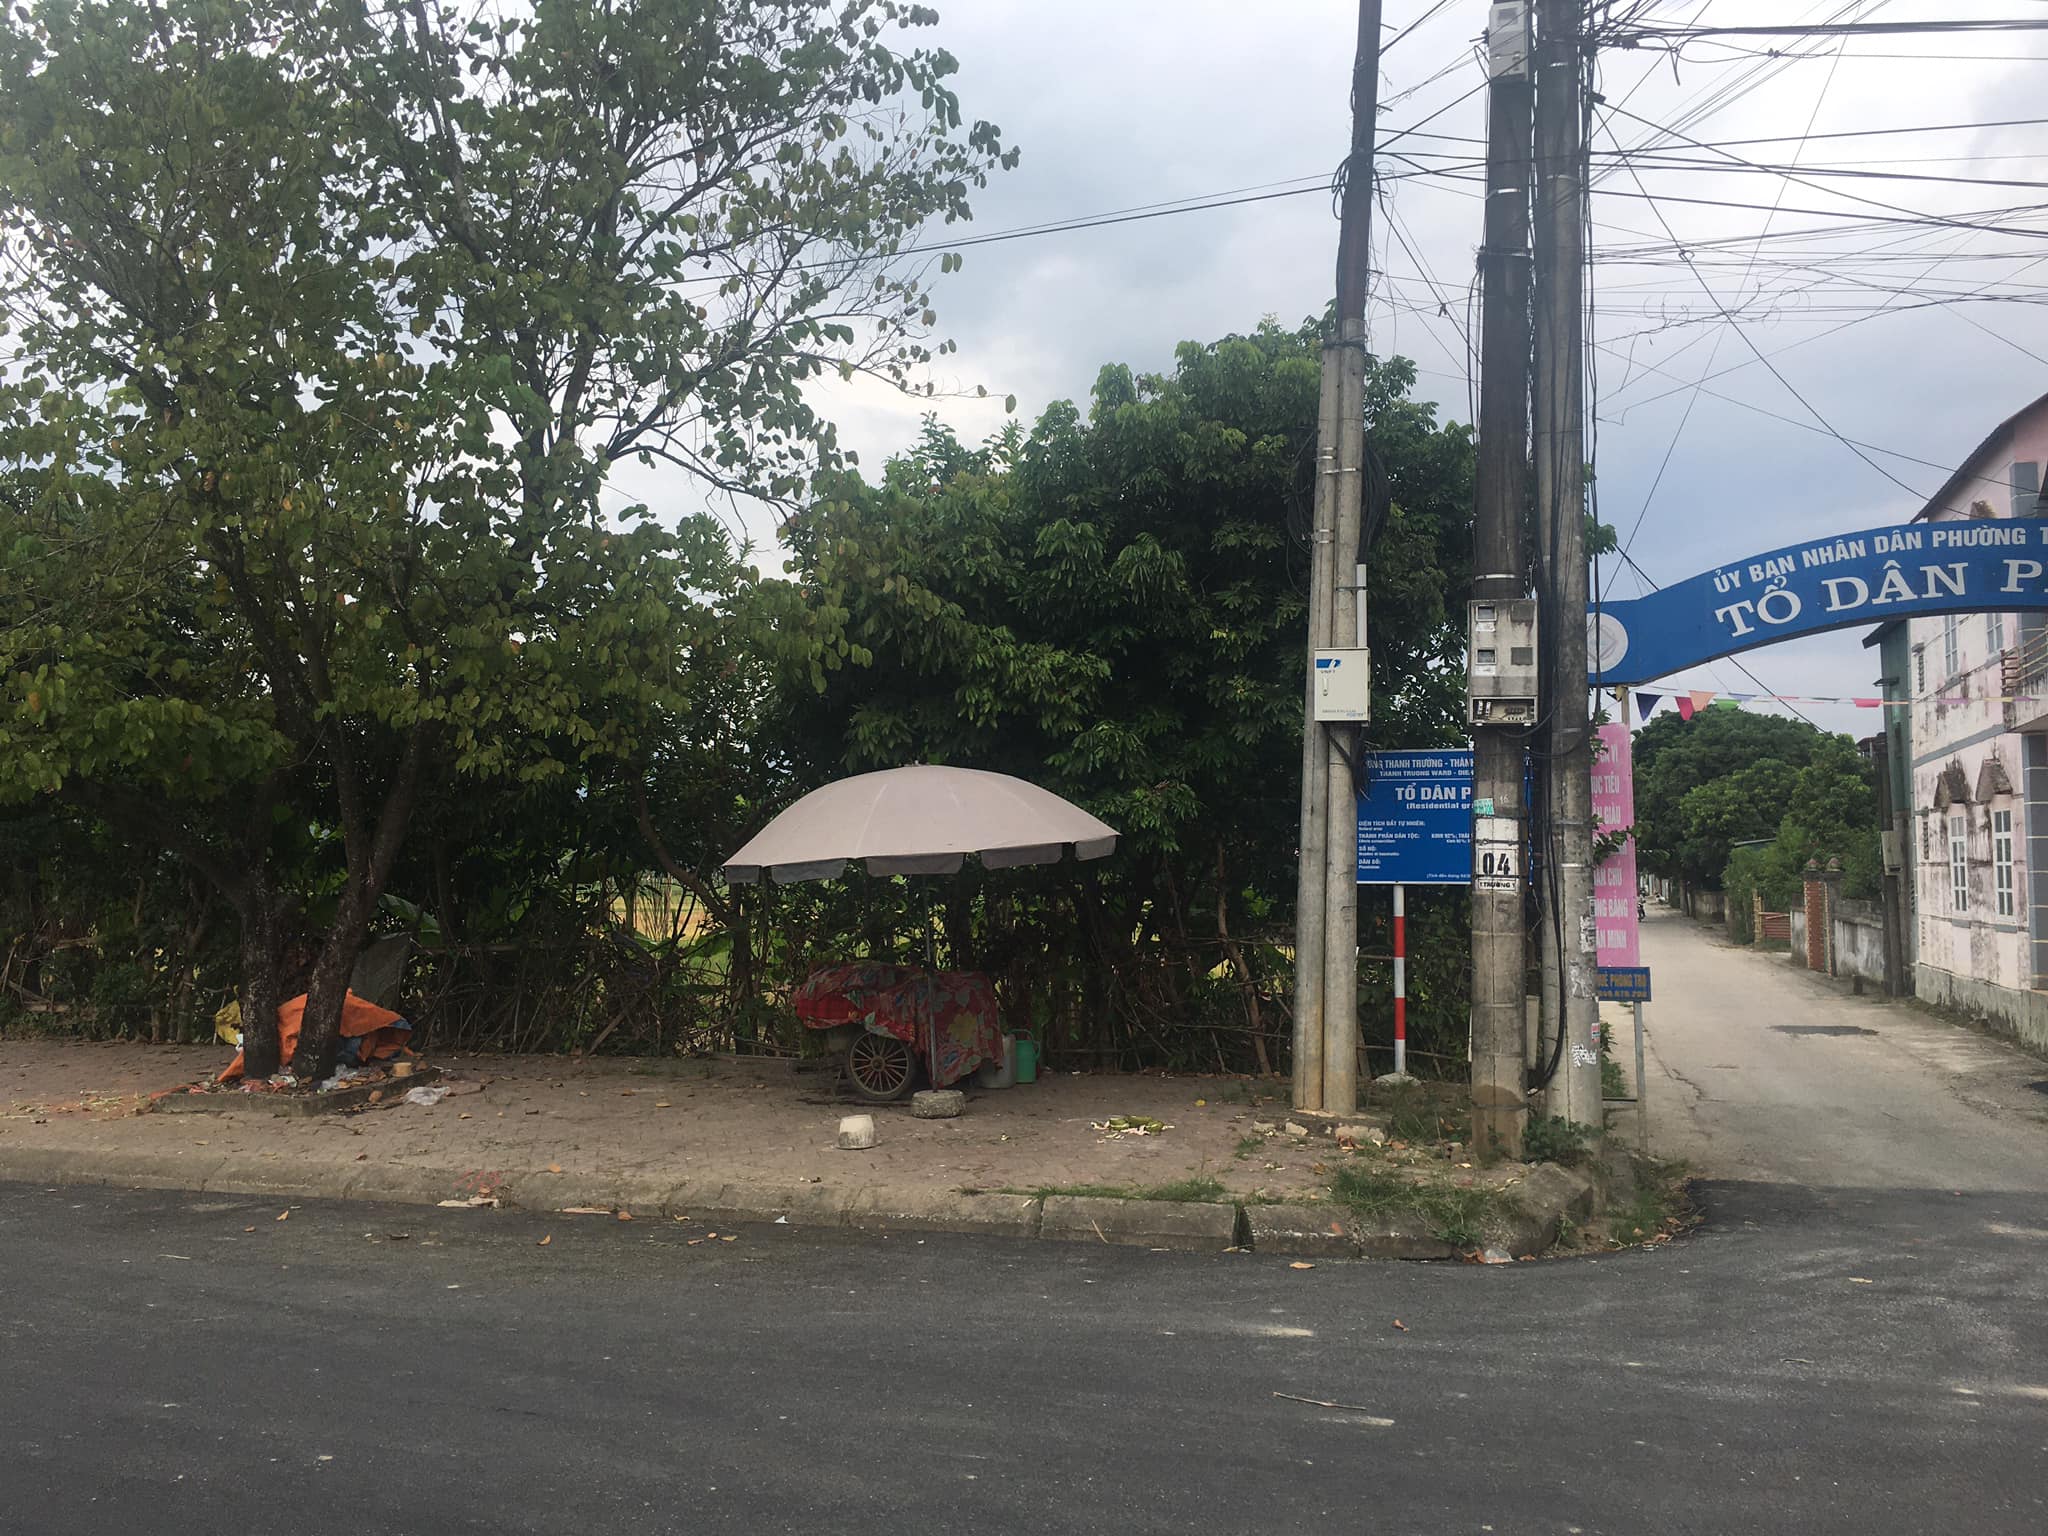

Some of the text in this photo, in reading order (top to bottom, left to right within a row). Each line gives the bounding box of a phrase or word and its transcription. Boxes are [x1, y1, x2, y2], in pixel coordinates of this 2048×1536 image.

[1713, 569, 1741, 593] ỦY
[1748, 555, 1796, 583] BAN
[1802, 539, 1866, 568] NHÂN
[1873, 529, 1922, 554] DÂN
[1932, 524, 2026, 548] PHƯỜNG
[1714, 559, 2048, 637] TỔ DÂN P
[1385, 760, 1410, 769] THANH
[1395, 782, 1416, 801] TỔ
[1421, 784, 1456, 800] DÂN
[1483, 852, 1510, 876] 04
